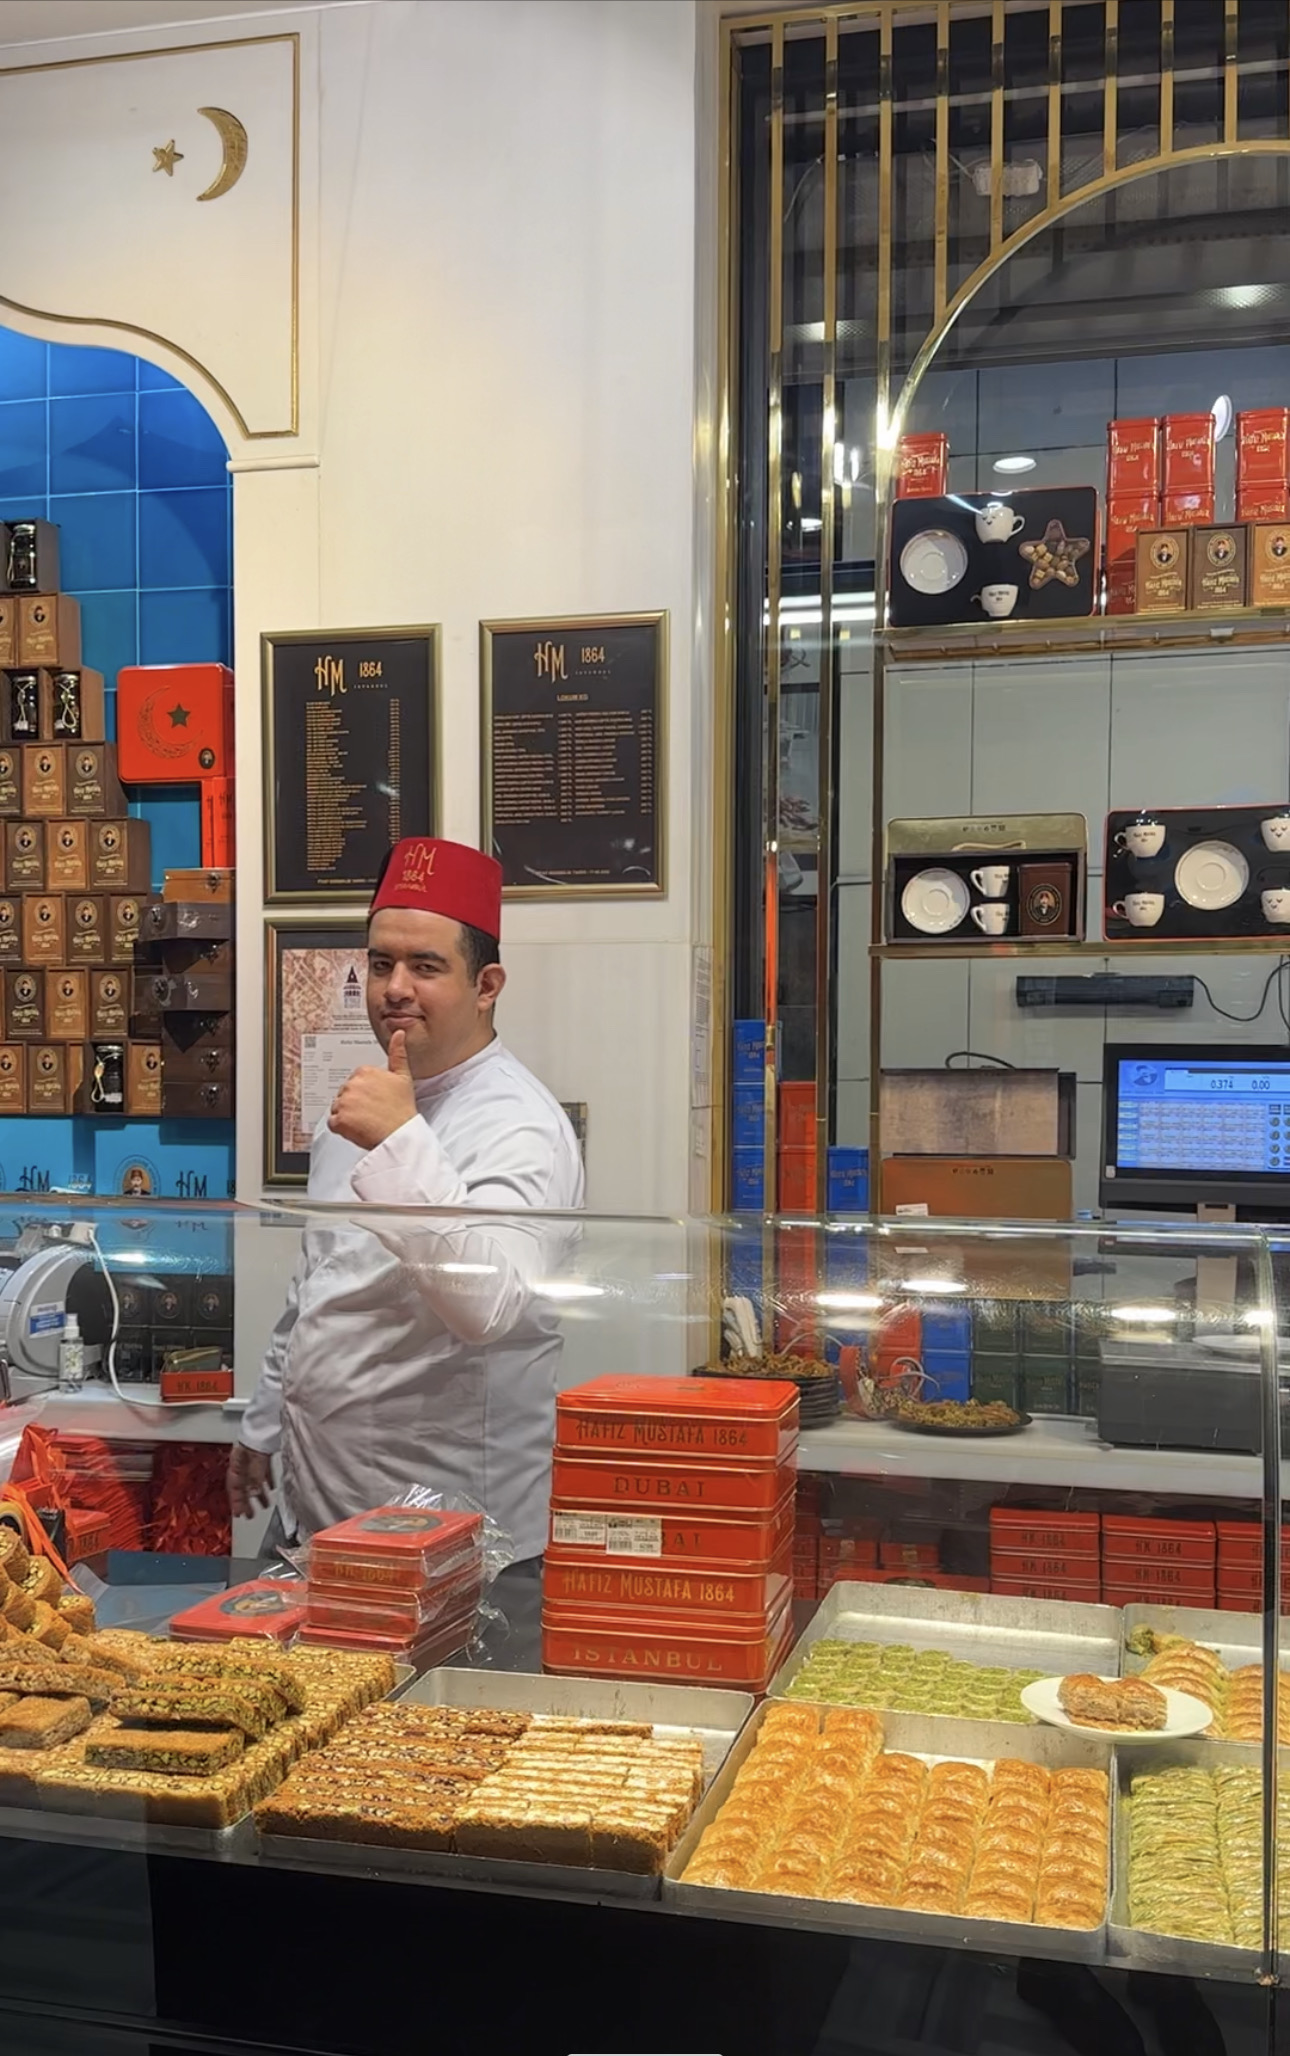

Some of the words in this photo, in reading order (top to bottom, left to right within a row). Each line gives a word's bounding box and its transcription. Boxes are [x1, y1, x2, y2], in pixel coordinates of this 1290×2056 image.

[314, 655, 347, 696] HM
[359, 661, 382, 677] 1864
[534, 641, 568, 683] HM
[581, 646, 605, 663] 1864
[404, 843, 436, 875] HM
[1251, 1080, 1271, 1090] 0.00
[176, 1169, 207, 1197] HM
[576, 1418, 626, 1441] HAFIZ
[633, 1419, 705, 1446] MUSTAFA
[714, 1428, 748, 1447] 1864
[614, 1476, 705, 1497] DUBAI
[562, 1569, 612, 1594] HAFIZ
[620, 1572, 692, 1599] MUSTAFA
[700, 1583, 735, 1602] 1864
